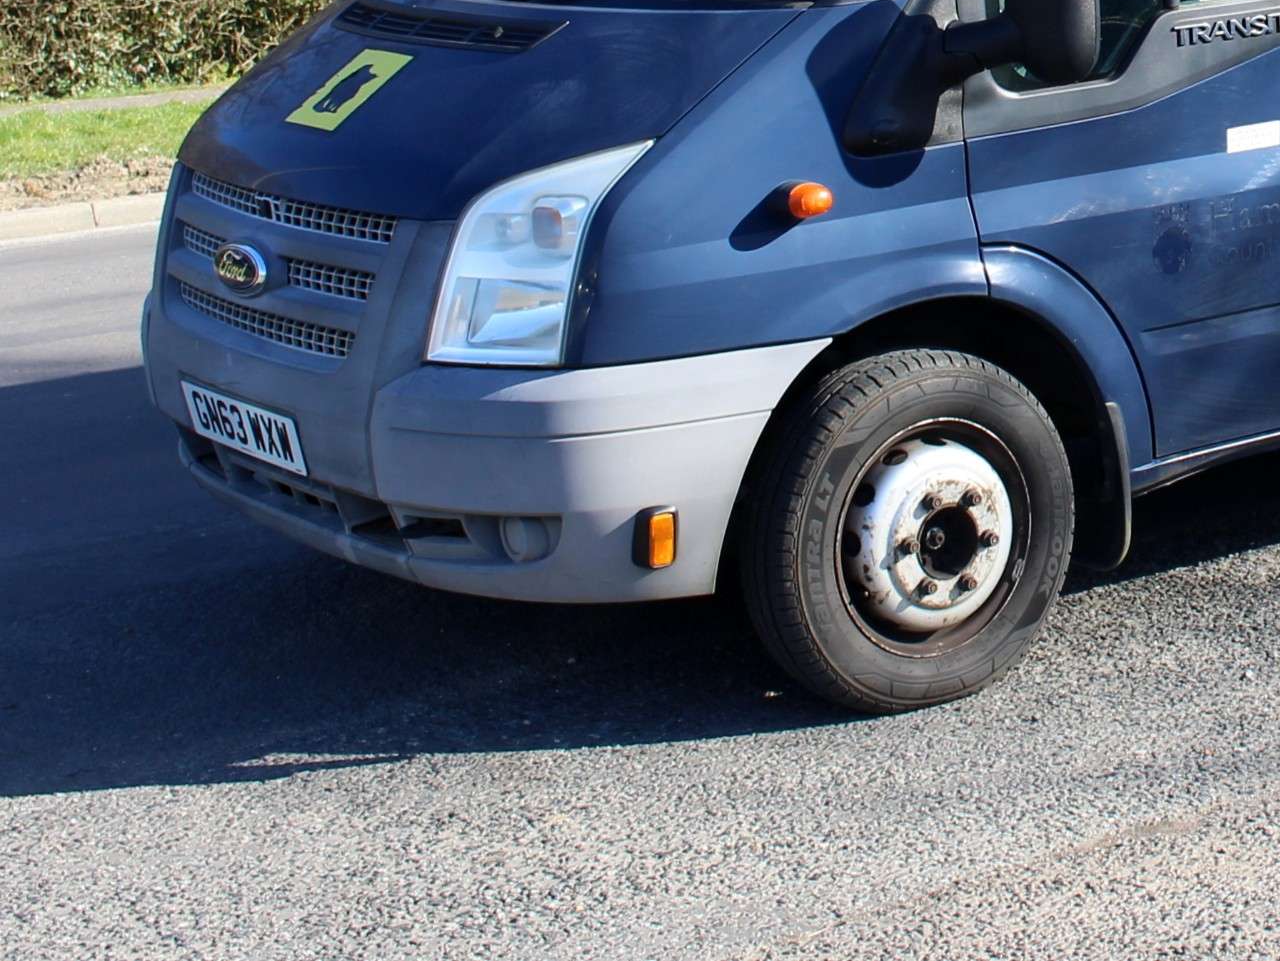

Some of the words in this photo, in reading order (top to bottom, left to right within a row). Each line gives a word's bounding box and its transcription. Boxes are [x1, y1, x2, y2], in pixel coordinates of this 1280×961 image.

[219, 250, 248, 282] Ford
[192, 390, 248, 445] GN63
[247, 409, 294, 463] WXW
[815, 471, 835, 512] LT
